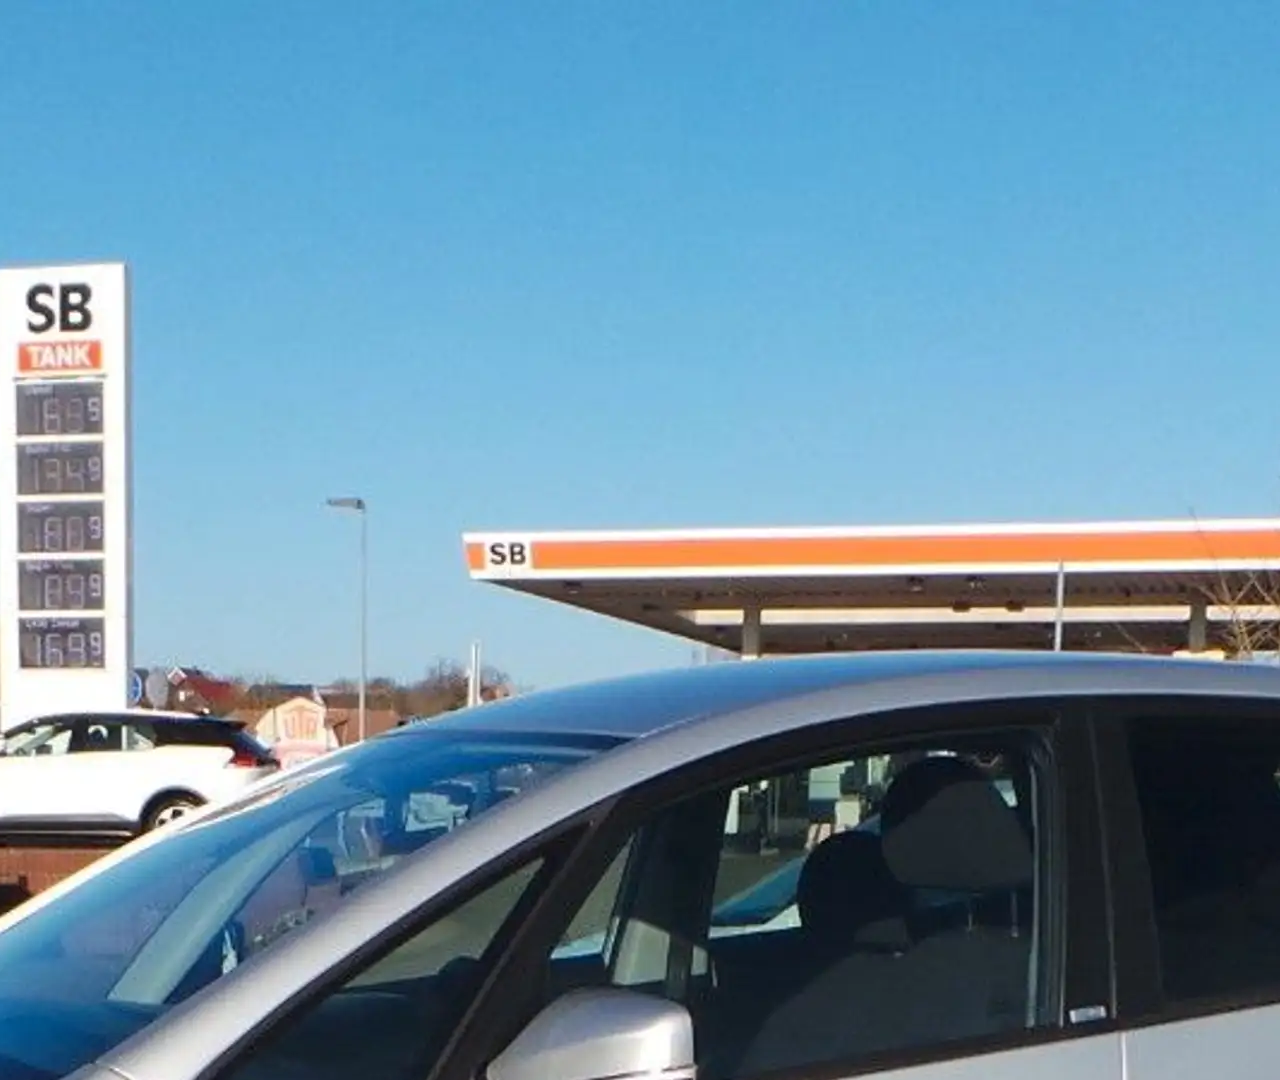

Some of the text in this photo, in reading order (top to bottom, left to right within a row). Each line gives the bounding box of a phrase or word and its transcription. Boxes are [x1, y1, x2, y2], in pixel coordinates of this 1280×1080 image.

[25, 283, 92, 334] SB
[26, 343, 92, 369] TANK
[489, 542, 526, 565] SB
